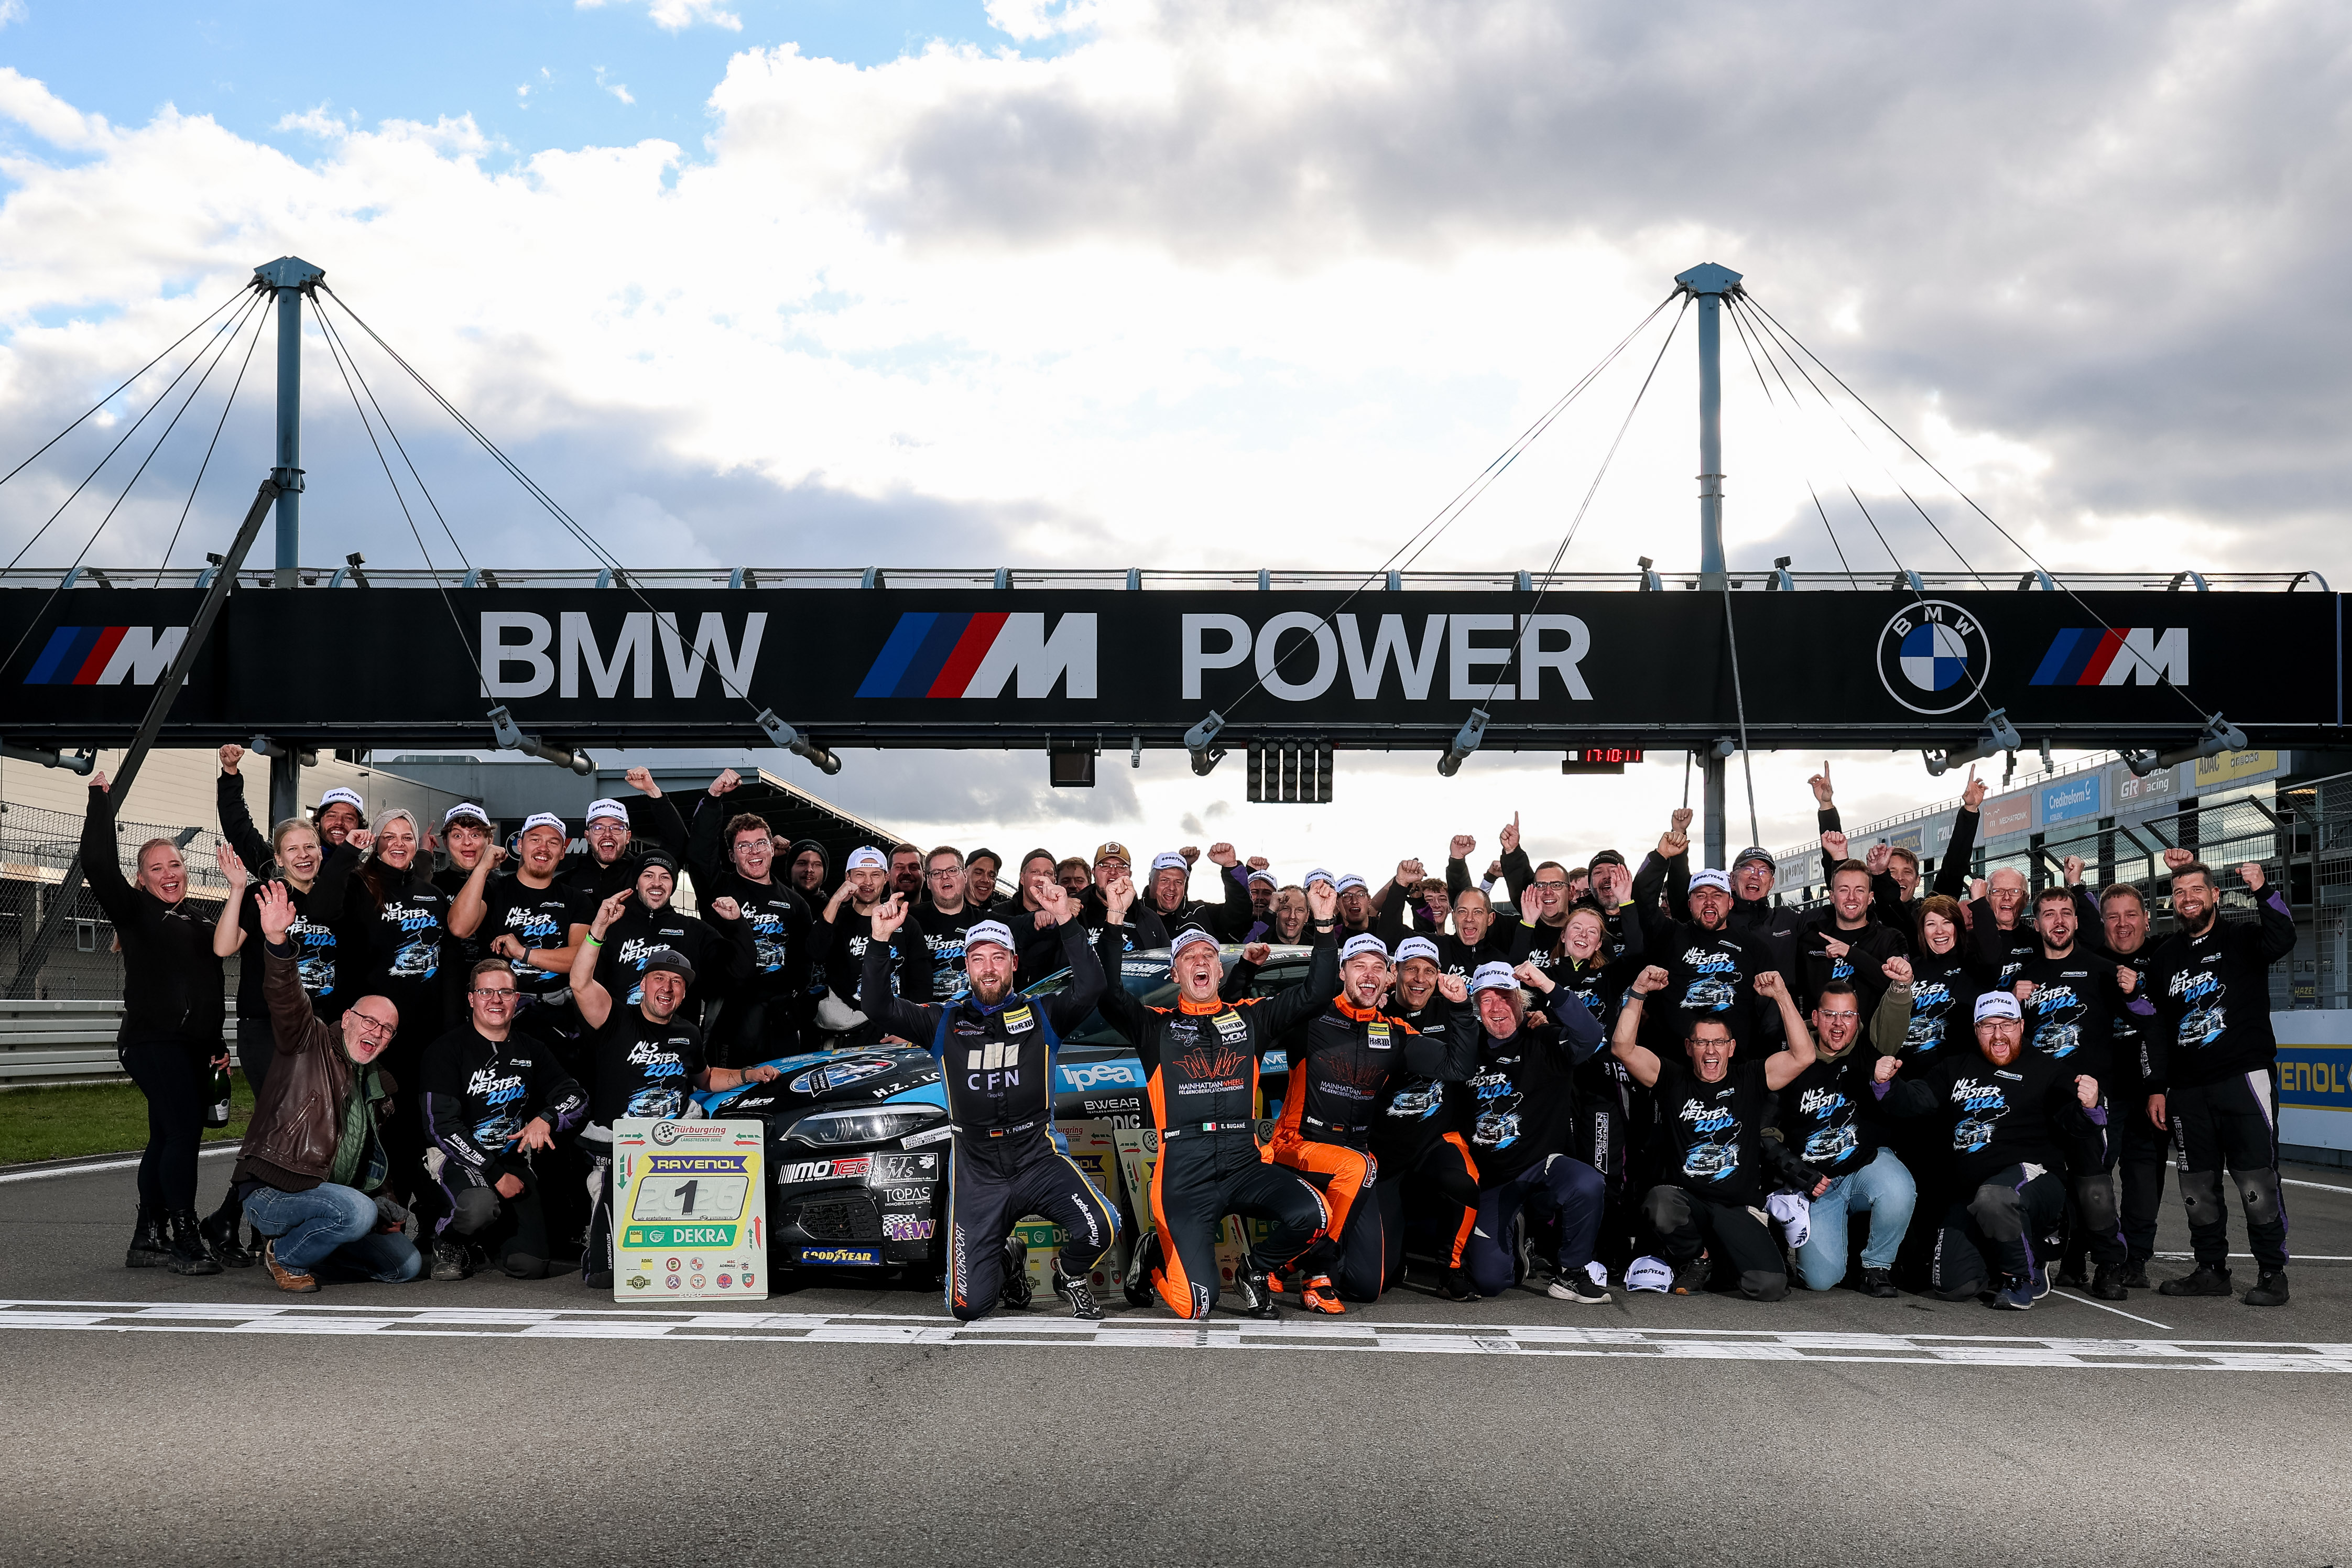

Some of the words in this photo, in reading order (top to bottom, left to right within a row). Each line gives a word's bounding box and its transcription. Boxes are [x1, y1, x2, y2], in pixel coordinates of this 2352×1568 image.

[1892, 606, 1975, 638] BMW
[481, 612, 768, 698] BMW
[961, 612, 1097, 698] M
[1182, 611, 1593, 701] POWER
[2099, 628, 2188, 685] M
[1586, 749, 1640, 762] 17:10:11
[2120, 781, 2139, 798] GR
[328, 792, 361, 803] GOODYEAR
[2049, 788, 2085, 810] Creditreform
[449, 807, 481, 816] GOODYEAR
[592, 803, 623, 812] GOODYEAR
[531, 817, 563, 828] GOODYEAR
[1999, 811, 2027, 825] MECHATRONIK
[1751, 847, 1771, 857] pixum
[1161, 855, 1186, 865] GOODYEAR
[1308, 871, 1332, 879] GOODYEAR
[1337, 877, 1363, 887] GOODYEAR
[1693, 874, 1724, 883] GOODYEAR
[382, 908, 431, 922] MEISTER
[508, 907, 531, 917] NLS
[294, 915, 307, 924] LS
[401, 915, 438, 932] 2026
[303, 933, 337, 946] 2026
[969, 927, 1007, 938] GOODYEAR
[623, 938, 645, 951] NLS
[849, 935, 869, 945] NLS
[1349, 939, 1384, 950] GOODYEAR
[1403, 943, 1436, 954] GOODYEAR
[1529, 949, 1548, 961] NLS
[1696, 960, 1735, 974] 2026
[1475, 970, 1509, 981] GOODYEAR
[2171, 969, 2189, 983] NLS
[2168, 971, 2215, 997] MEISTER
[2184, 977, 2218, 1003] 2026
[1915, 989, 1950, 1010] 2026
[1979, 997, 2012, 1009] GOODYEAR
[2024, 985, 2072, 1010] MEISTER
[2038, 994, 2078, 1015] 2026
[1322, 1015, 1351, 1027] ADRENALIN
[1171, 1029, 1200, 1047] Prestige
[1221, 1030, 1247, 1042] MDM
[633, 1040, 660, 1053] NLS
[627, 1051, 681, 1066] MEISTER
[471, 1068, 496, 1083] NLS
[644, 1062, 685, 1077] 2026
[1059, 1064, 1136, 1092] ipea
[1954, 1077, 1978, 1091] NLS
[466, 1075, 521, 1096] MEISTER
[872, 1082, 910, 1098] H.Z.
[1477, 1083, 1513, 1099] 2026
[486, 1084, 526, 1105] 2026
[1802, 1087, 1825, 1102] NLS
[1950, 1085, 2001, 1103] MEISTER
[1084, 1097, 1140, 1110] BWEAR
[1683, 1098, 1704, 1112] NLS
[1964, 1095, 2005, 1112] 2026
[1679, 1105, 1729, 1121] MEISTER
[1013, 1121, 1034, 1133] FÜBRICH
[1306, 1116, 1324, 1127] freem
[1694, 1115, 1734, 1133] 2026
[674, 1125, 726, 1135] nürburgring
[450, 1133, 471, 1153] NEXEN
[470, 1149, 486, 1163] TIRE
[1595, 1114, 1604, 1169] ADRENALIN
[2172, 1116, 2184, 1149] NEXEN
[2179, 1151, 2189, 1172] TIRE
[657, 1159, 740, 1170] RAVENOL
[793, 1158, 872, 1179] MOTEC
[886, 1157, 912, 1169] ET
[887, 1167, 914, 1179] MS
[674, 1180, 699, 1215] 1
[883, 1186, 930, 1202] TOPAS
[673, 1228, 728, 1243] DEKRA
[892, 1219, 937, 1242] KW
[1934, 1228, 1944, 1262] NEXEN
[957, 1223, 967, 1297] MOTORSPORT
[1632, 1267, 1665, 1278] GOODYEAR
